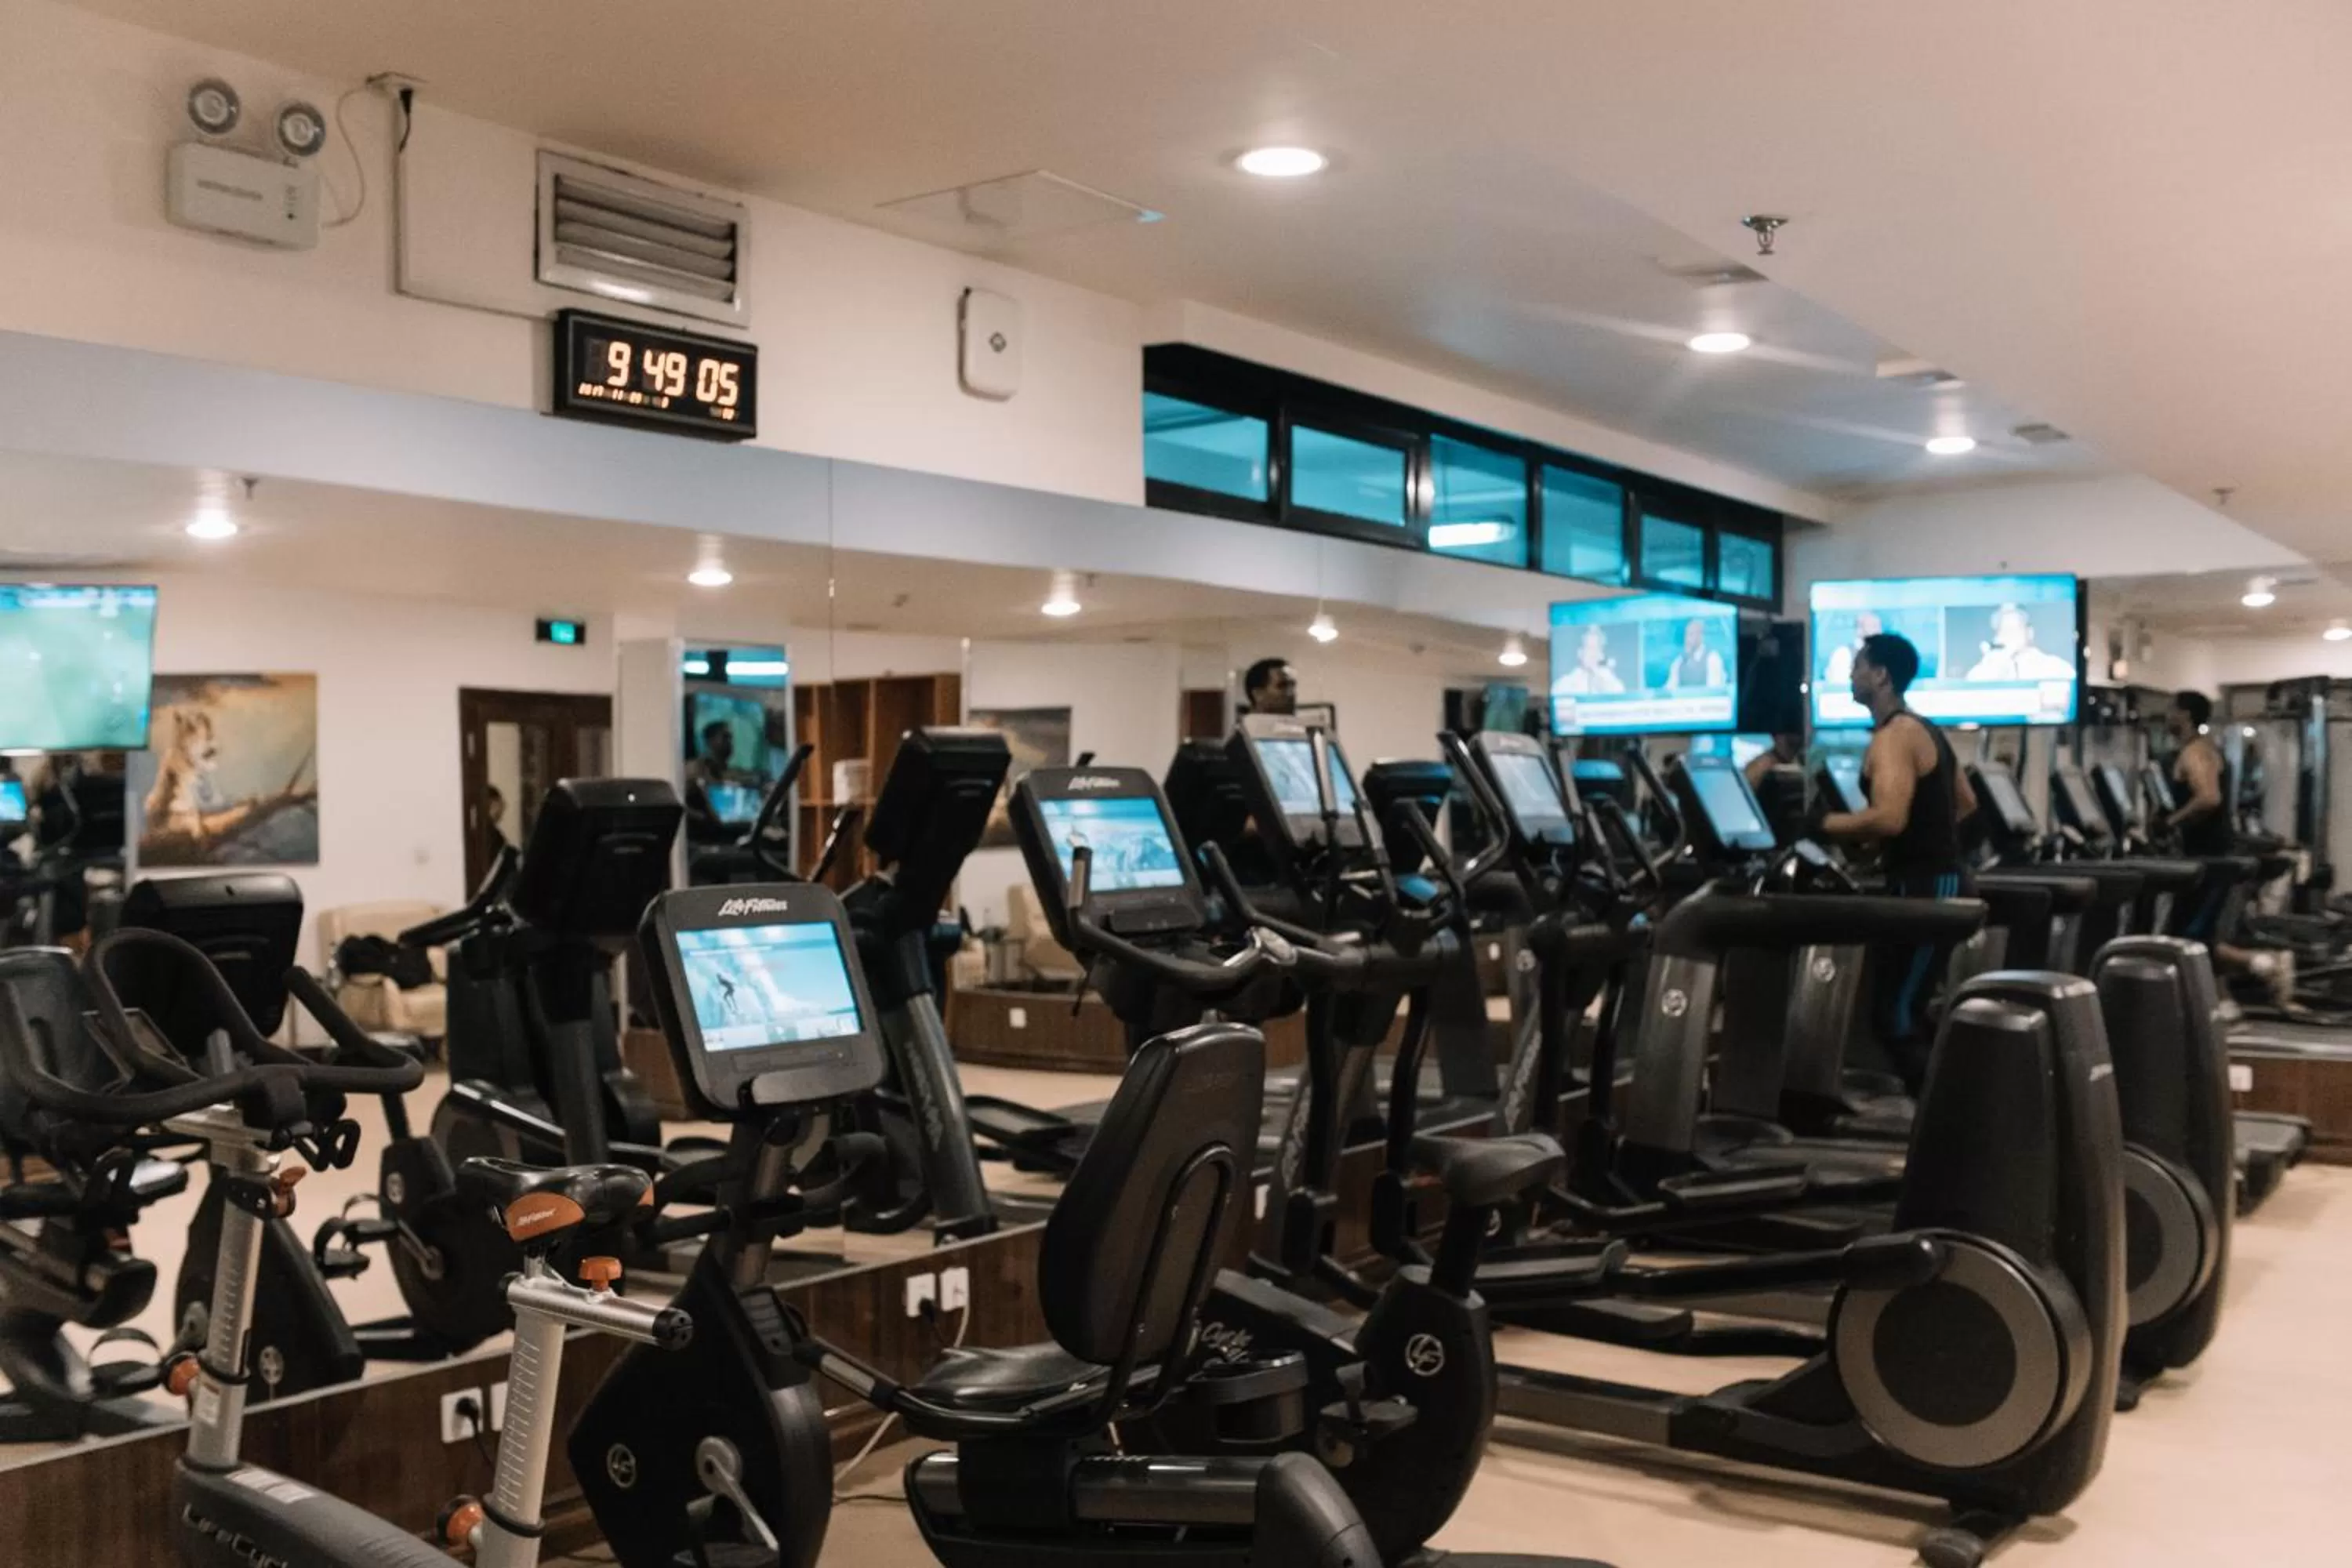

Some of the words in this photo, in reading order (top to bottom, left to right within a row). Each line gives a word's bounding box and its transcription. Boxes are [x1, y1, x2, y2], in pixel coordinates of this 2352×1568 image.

[607, 340, 632, 387] 9
[643, 349, 688, 397] 49
[695, 358, 740, 406] 05
